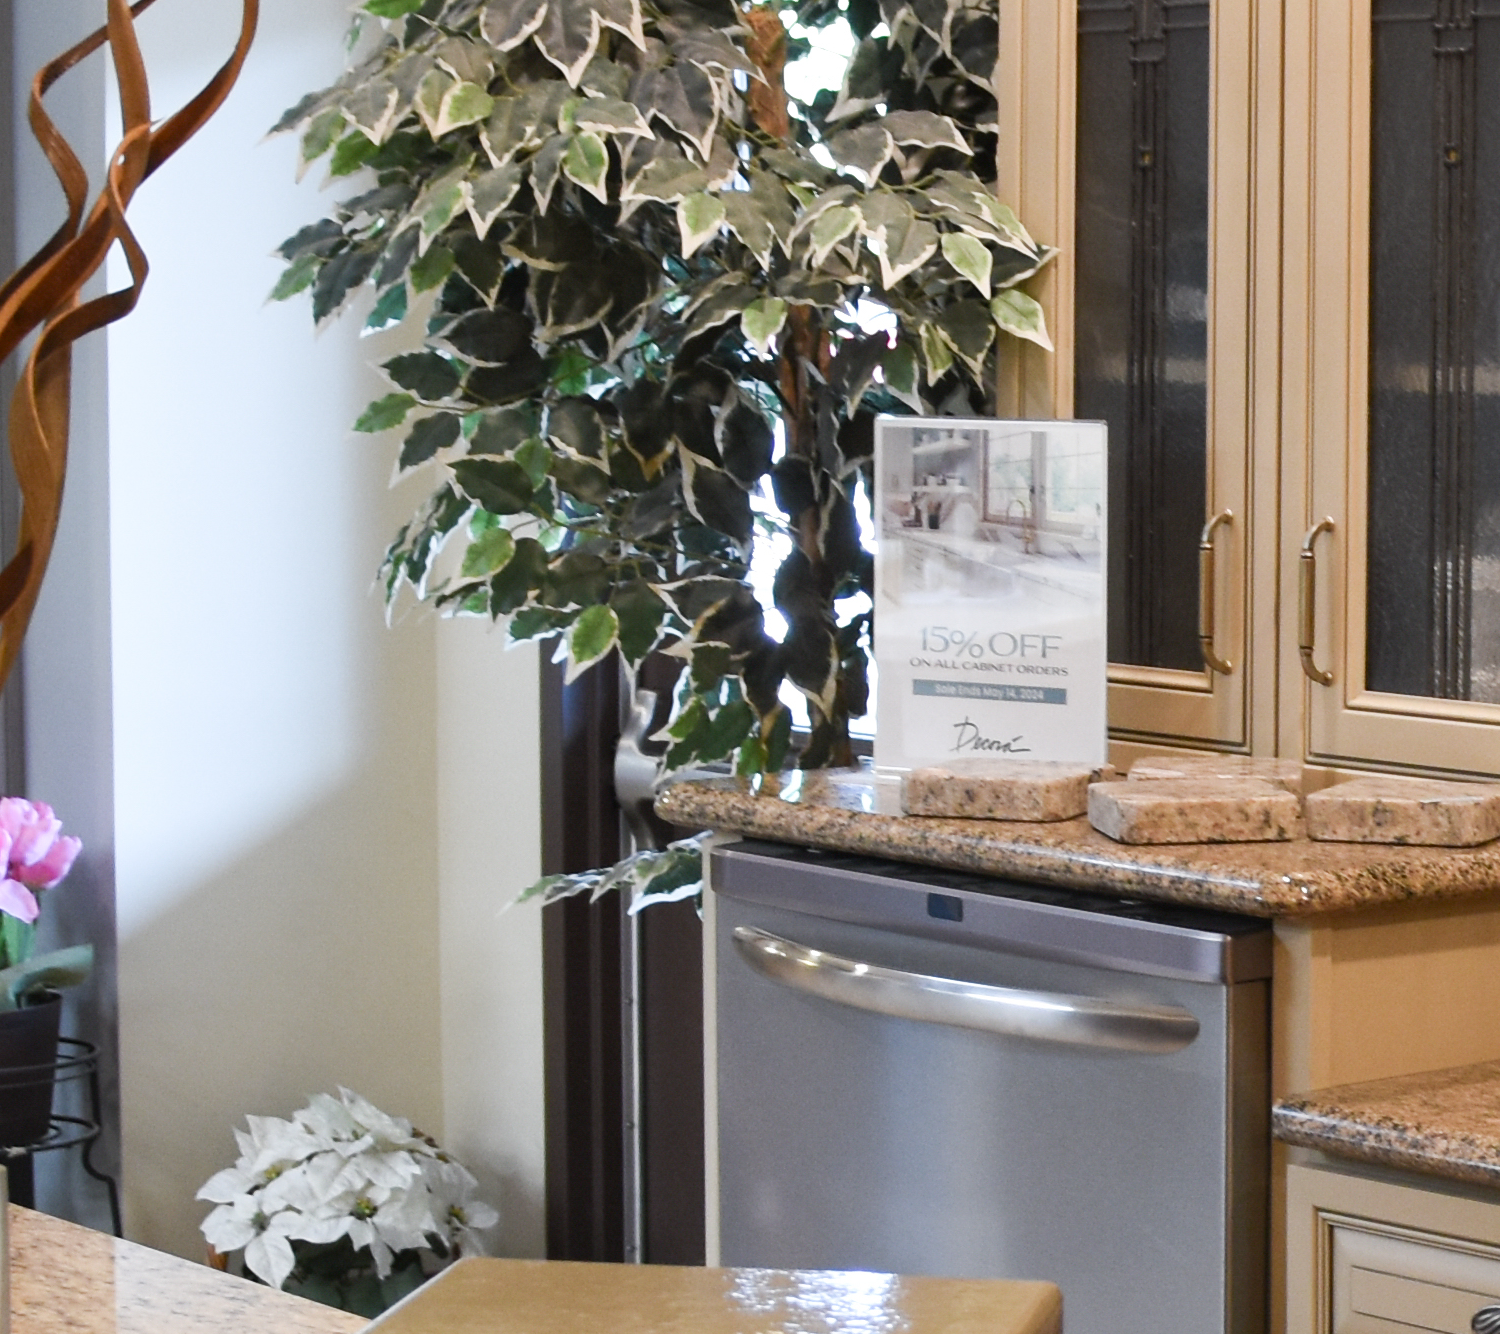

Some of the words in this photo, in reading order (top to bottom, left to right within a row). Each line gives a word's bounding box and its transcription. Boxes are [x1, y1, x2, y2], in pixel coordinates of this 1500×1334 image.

[921, 626, 984, 659] 15%
[988, 632, 1062, 659] OFF
[909, 656, 931, 667] ON
[934, 659, 959, 670] ALL
[962, 661, 1013, 673] CABINET
[1016, 664, 1069, 676] ORDERS
[935, 683, 956, 695] Sale
[958, 685, 981, 697] Ends
[983, 687, 1003, 700] May
[1020, 688, 1044, 701] 2024
